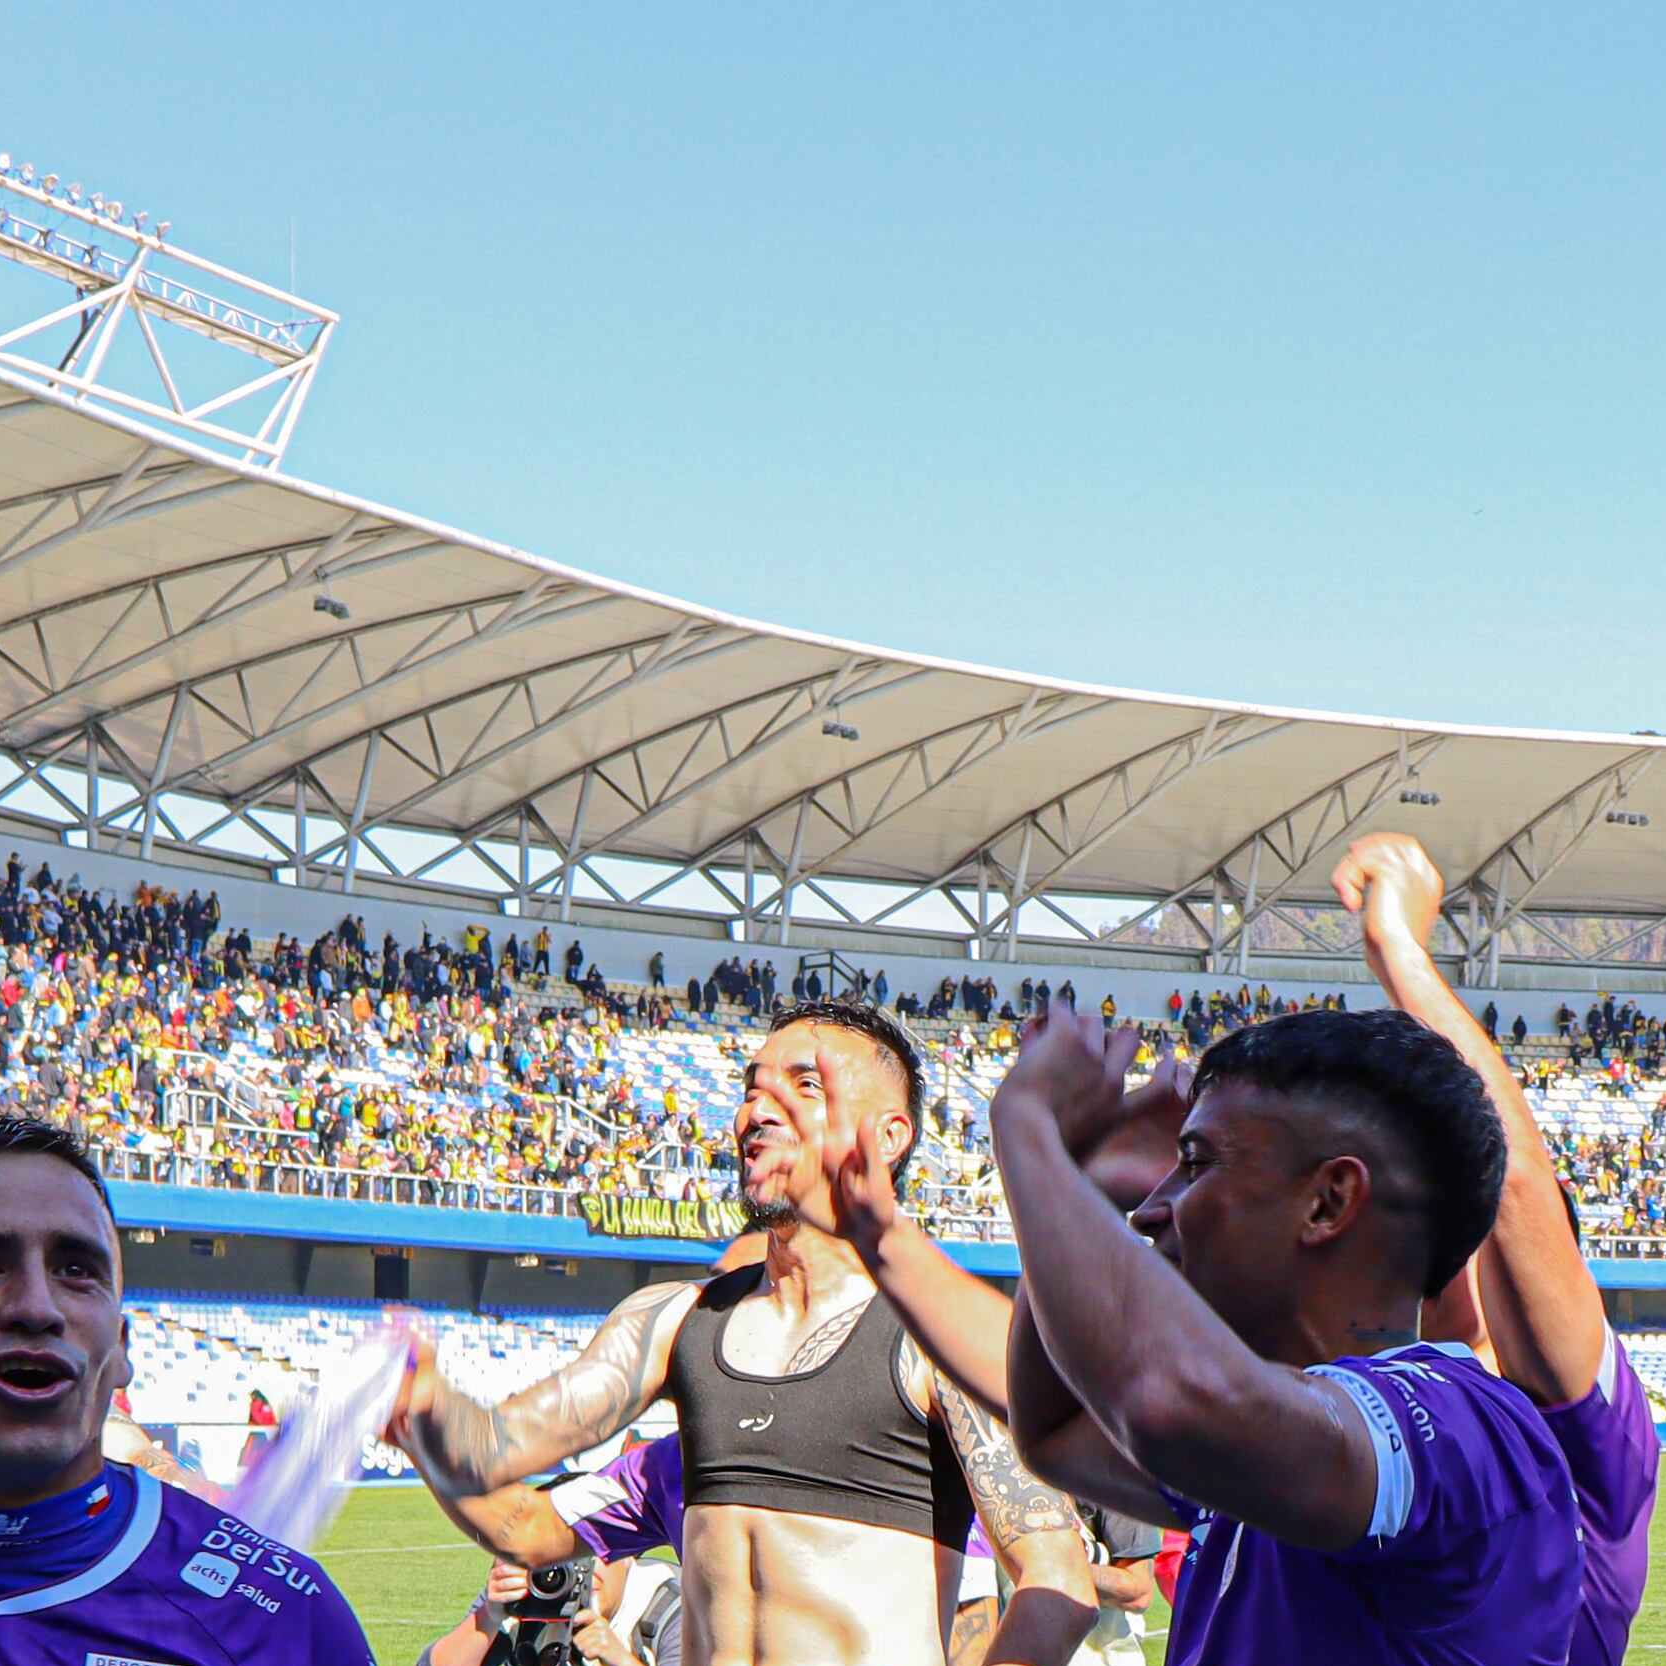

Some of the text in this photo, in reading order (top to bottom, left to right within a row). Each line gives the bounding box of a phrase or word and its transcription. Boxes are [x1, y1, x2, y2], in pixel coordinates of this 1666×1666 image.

[190, 1562, 229, 1587] achs
[201, 1529, 322, 1597] Del Sur
[234, 1583, 282, 1614] salud
